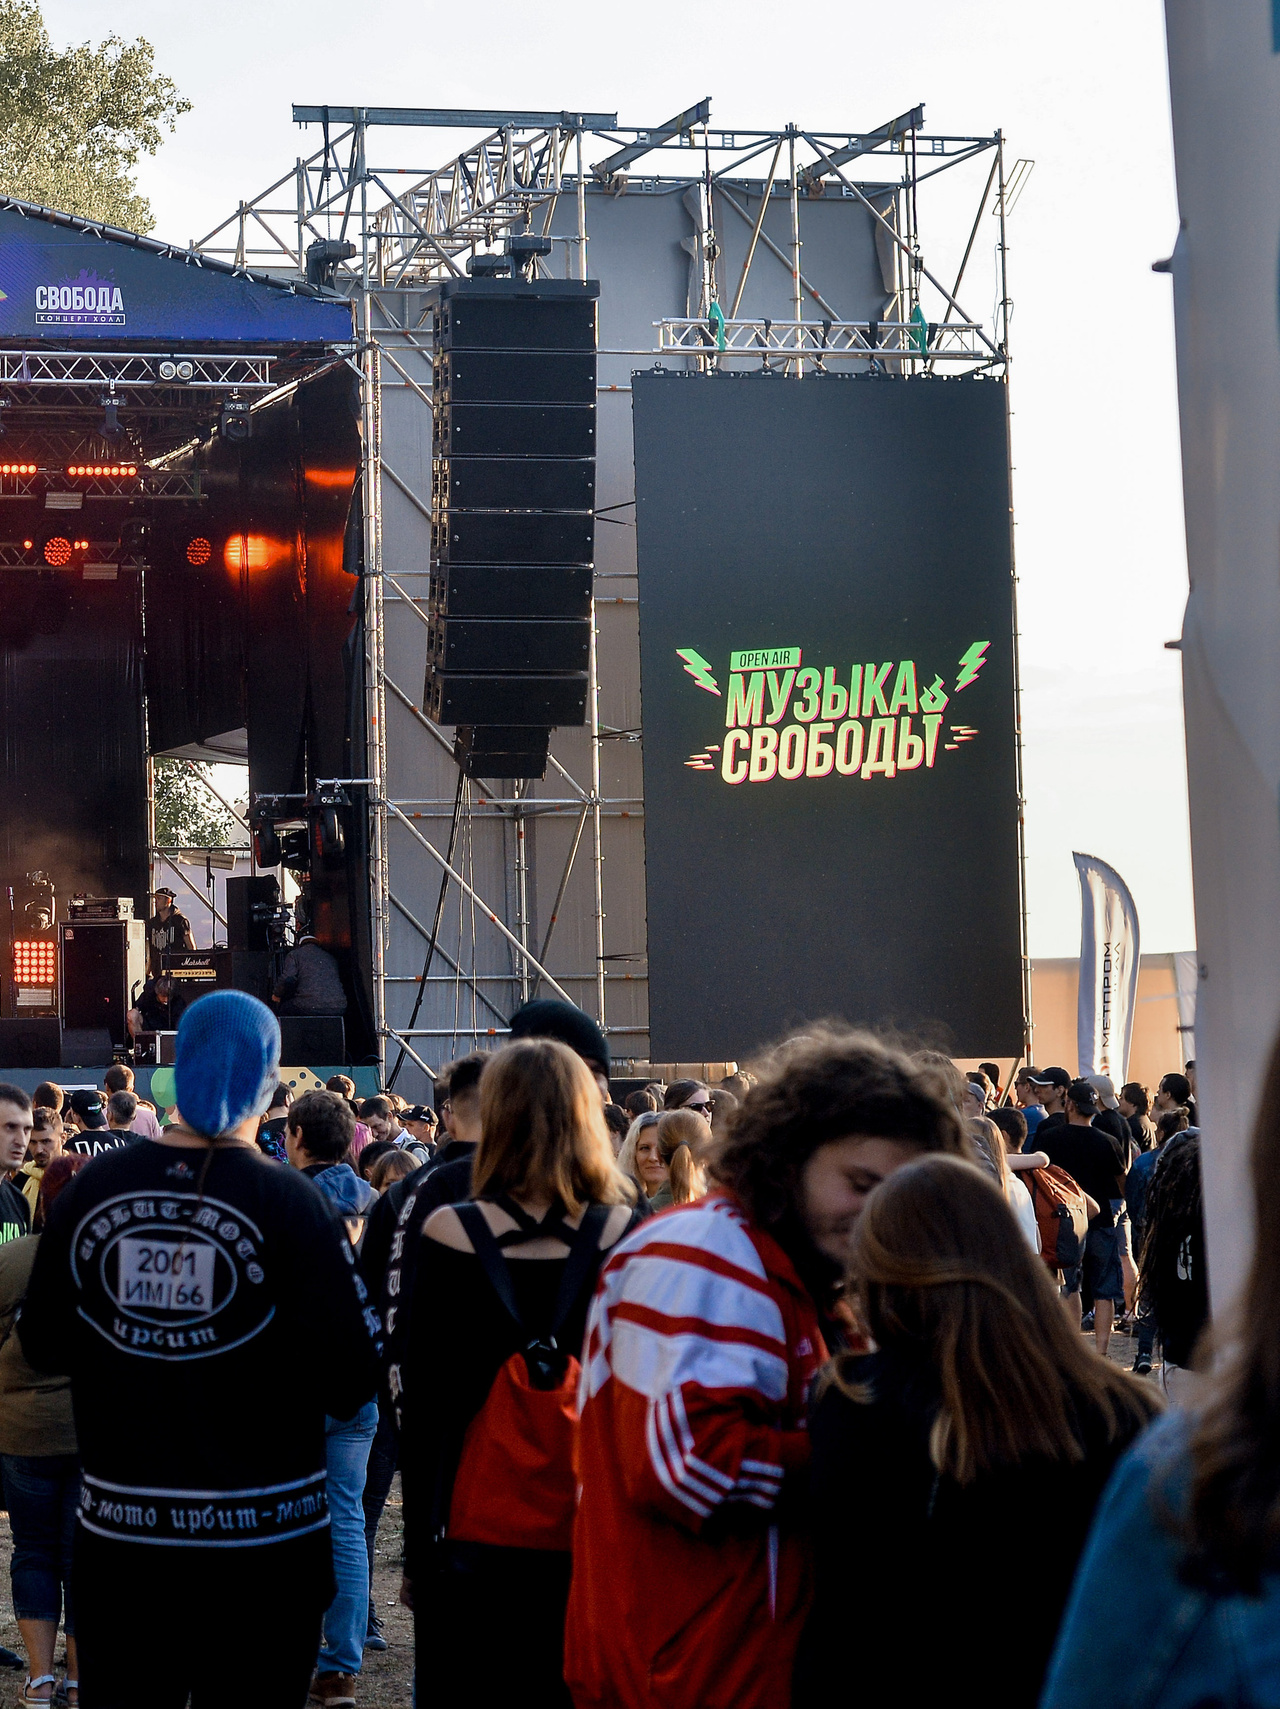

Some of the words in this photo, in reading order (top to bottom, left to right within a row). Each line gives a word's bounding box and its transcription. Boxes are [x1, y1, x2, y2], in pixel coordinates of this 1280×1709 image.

[35, 286, 124, 313] СВОБОДА
[739, 651, 769, 668] OPEN
[770, 650, 791, 665] AIR
[725, 660, 919, 728] МУЗЫКА
[721, 713, 944, 785] СВОБОДЫ
[181, 957, 211, 967] Marshall
[1102, 942, 1112, 1048] МЕТПРОМ
[138, 1248, 197, 1276] 2001
